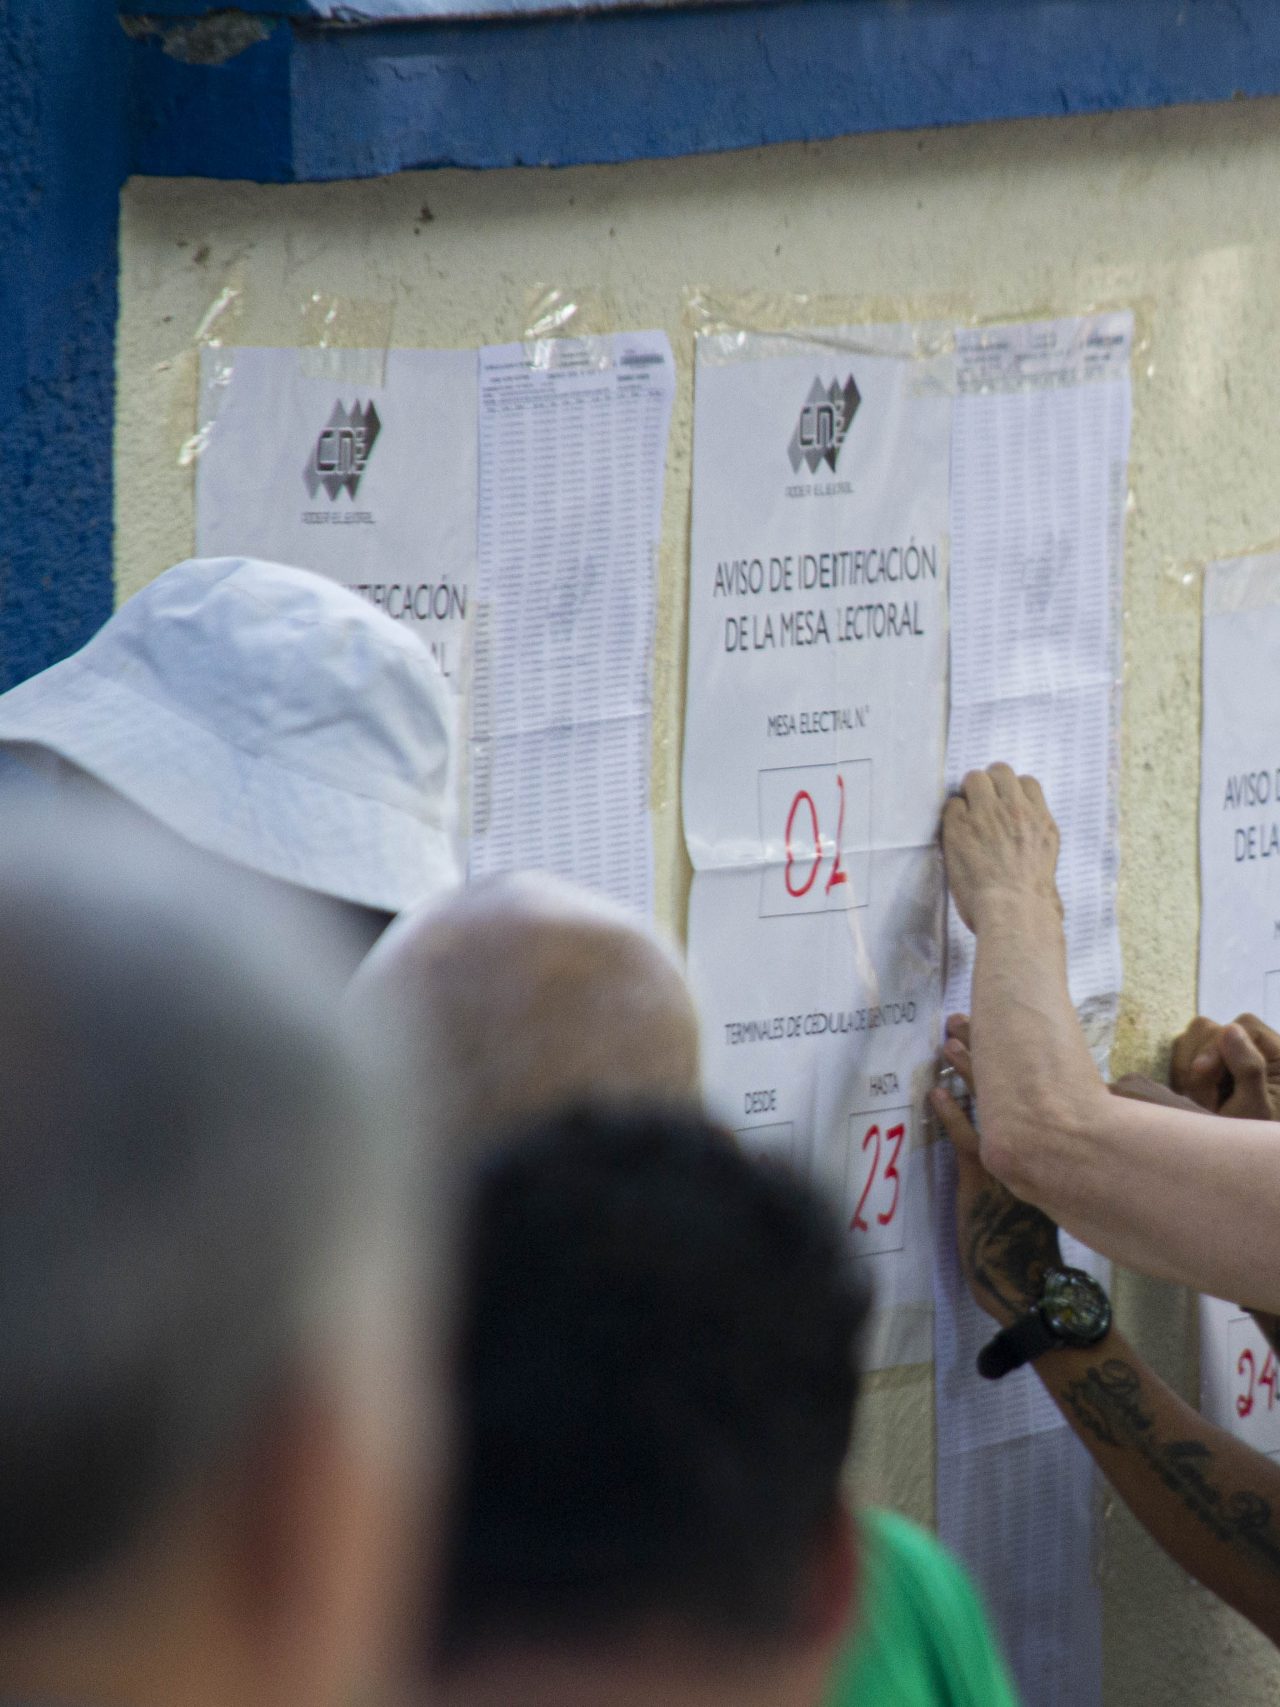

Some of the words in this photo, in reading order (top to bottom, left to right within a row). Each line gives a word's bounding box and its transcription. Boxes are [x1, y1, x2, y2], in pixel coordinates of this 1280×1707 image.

[713, 559, 764, 597] AVISO
[769, 556, 793, 592] DE
[725, 616, 749, 652] DE
[753, 614, 776, 649] LA
[780, 609, 830, 646] MESA
[767, 714, 797, 736] MESA
[1224, 770, 1271, 810] AVISO
[1234, 826, 1256, 862] DE
[1260, 824, 1280, 858] LA
[744, 1088, 776, 1115] DESDE
[850, 1123, 905, 1232] 23
